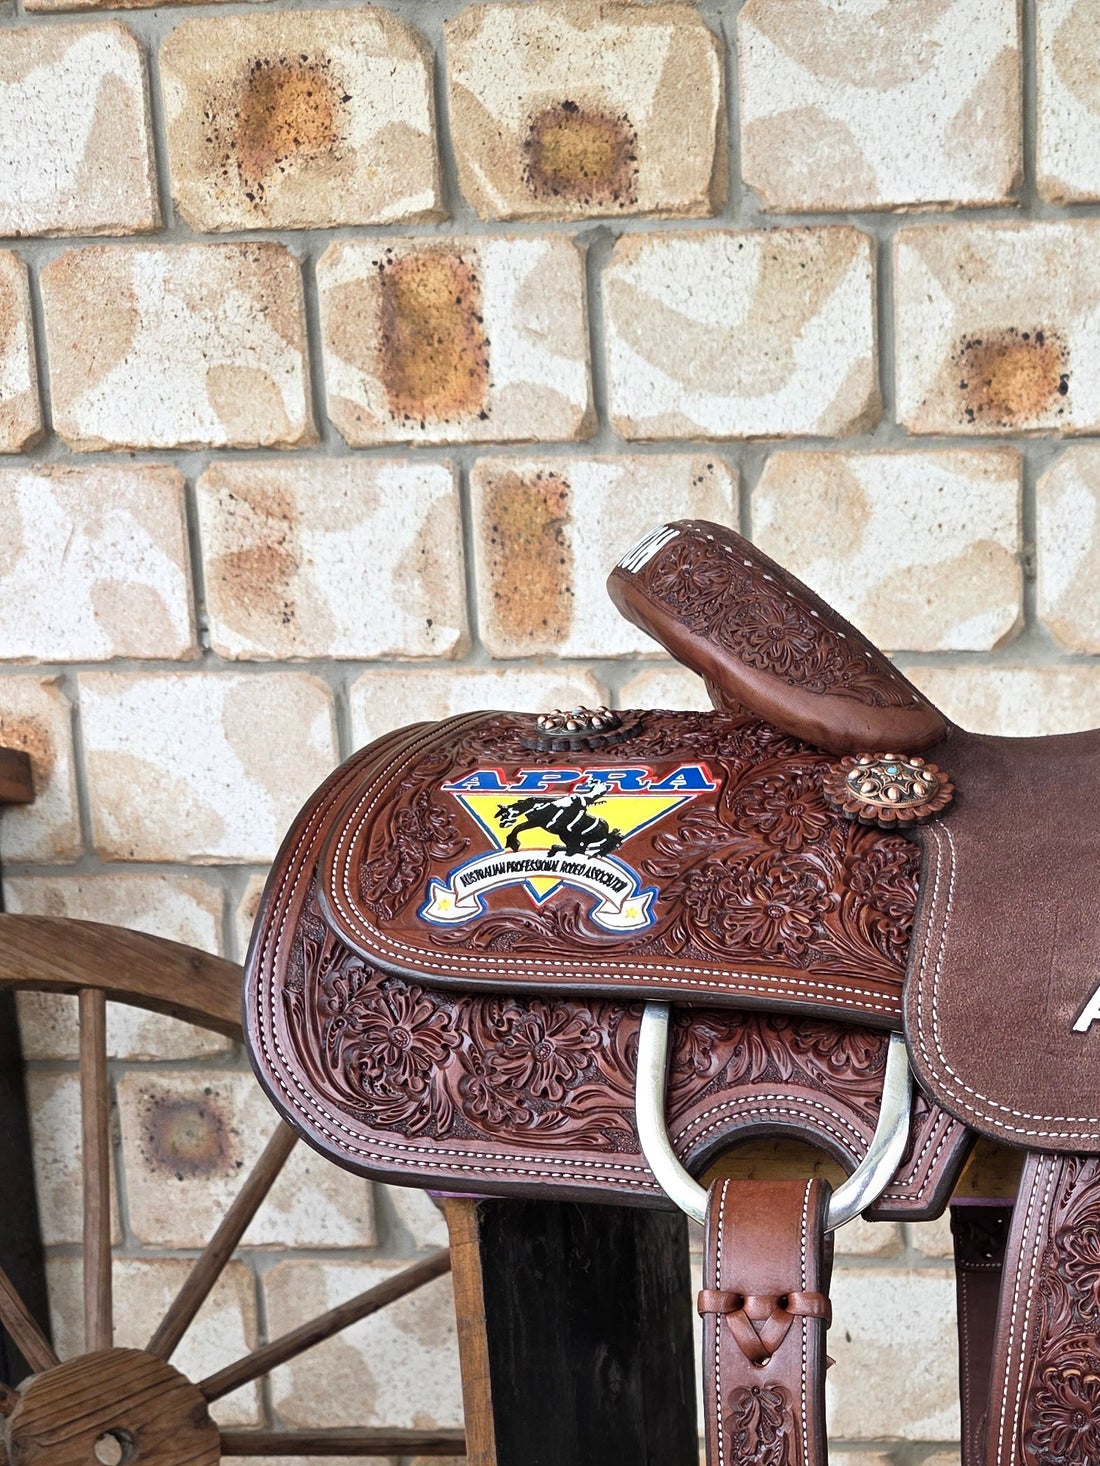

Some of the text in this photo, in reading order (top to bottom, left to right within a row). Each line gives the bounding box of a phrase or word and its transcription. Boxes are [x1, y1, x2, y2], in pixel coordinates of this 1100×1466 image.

[443, 765, 719, 793] APRA
[459, 861, 506, 887] AUSTRALIAN
[506, 859, 559, 874] PROFESSIONAL
[560, 860, 586, 875] RODEO
